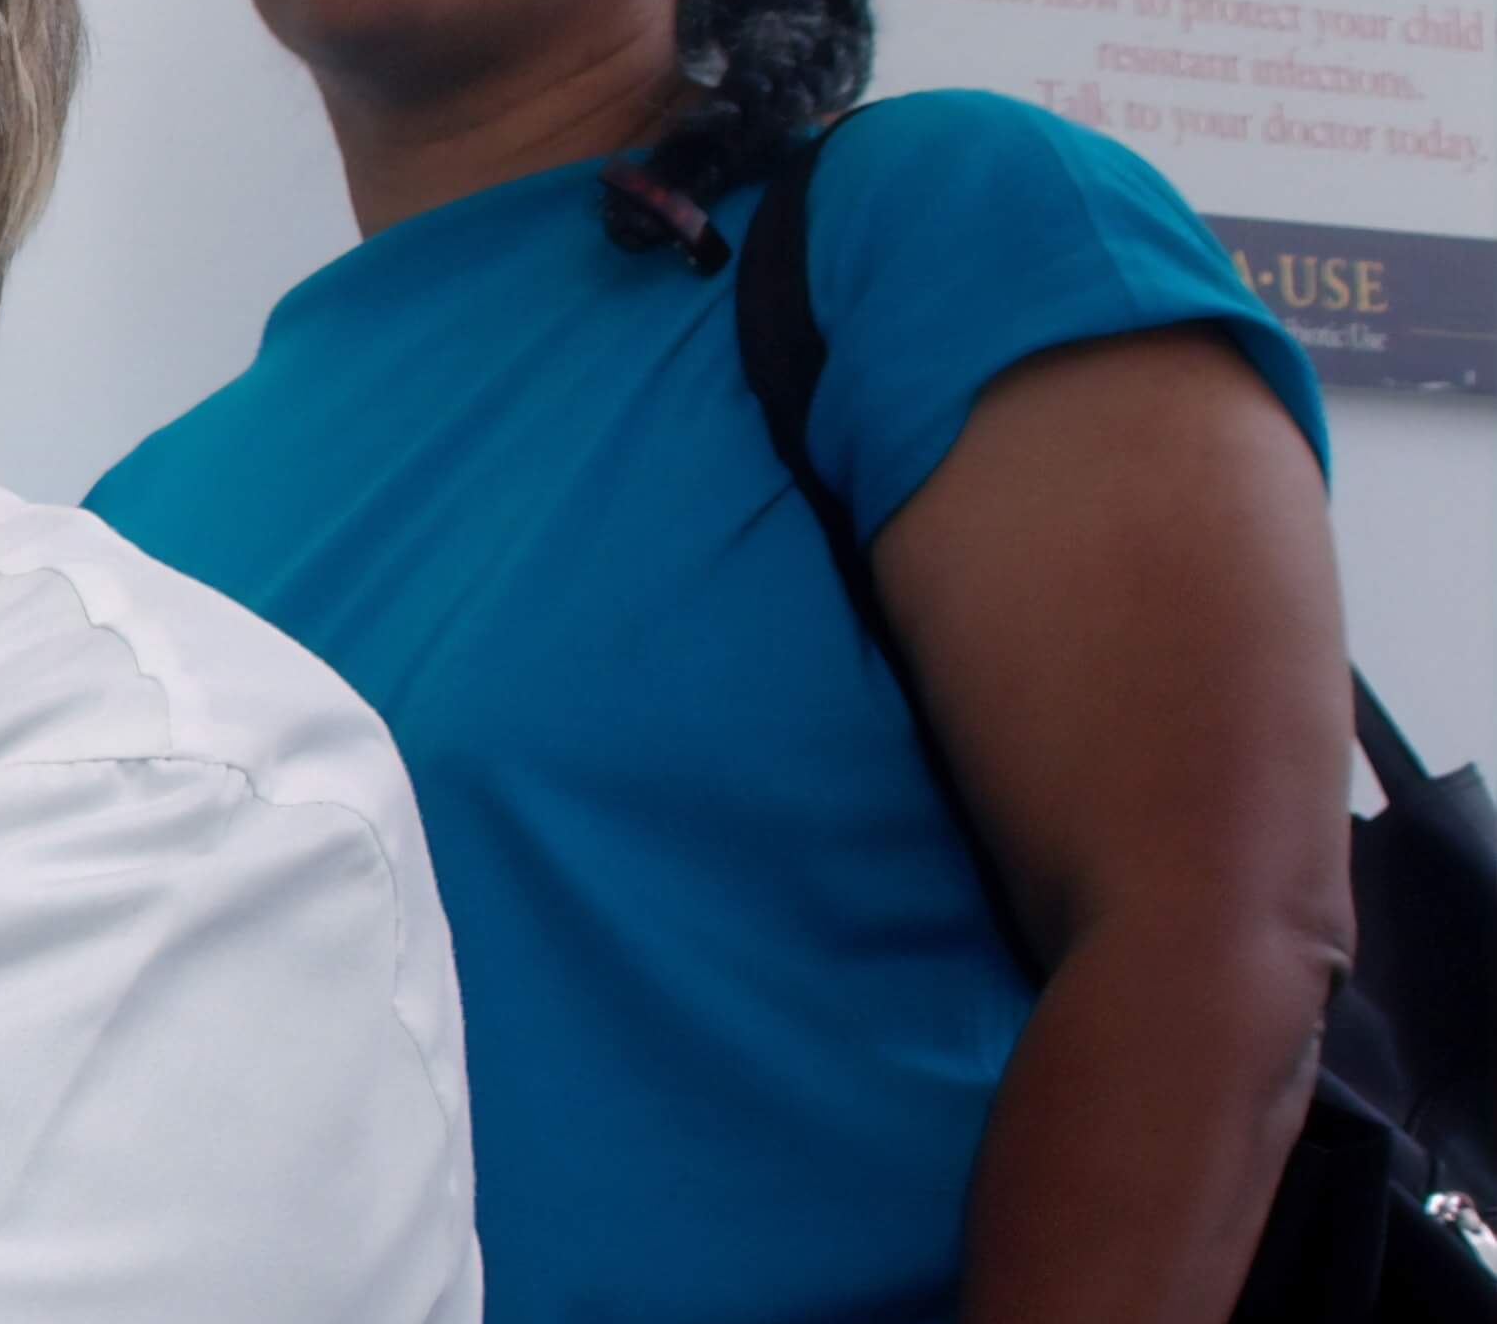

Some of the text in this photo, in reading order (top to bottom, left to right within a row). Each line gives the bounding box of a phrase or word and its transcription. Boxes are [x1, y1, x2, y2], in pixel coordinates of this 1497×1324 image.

[1312, 7, 1394, 48] your
[1401, 4, 1484, 52] child
[1034, 78, 1114, 127] Talk
[1123, 100, 1160, 133] to
[1170, 106, 1253, 147] your
[1261, 101, 1375, 153] doctor
